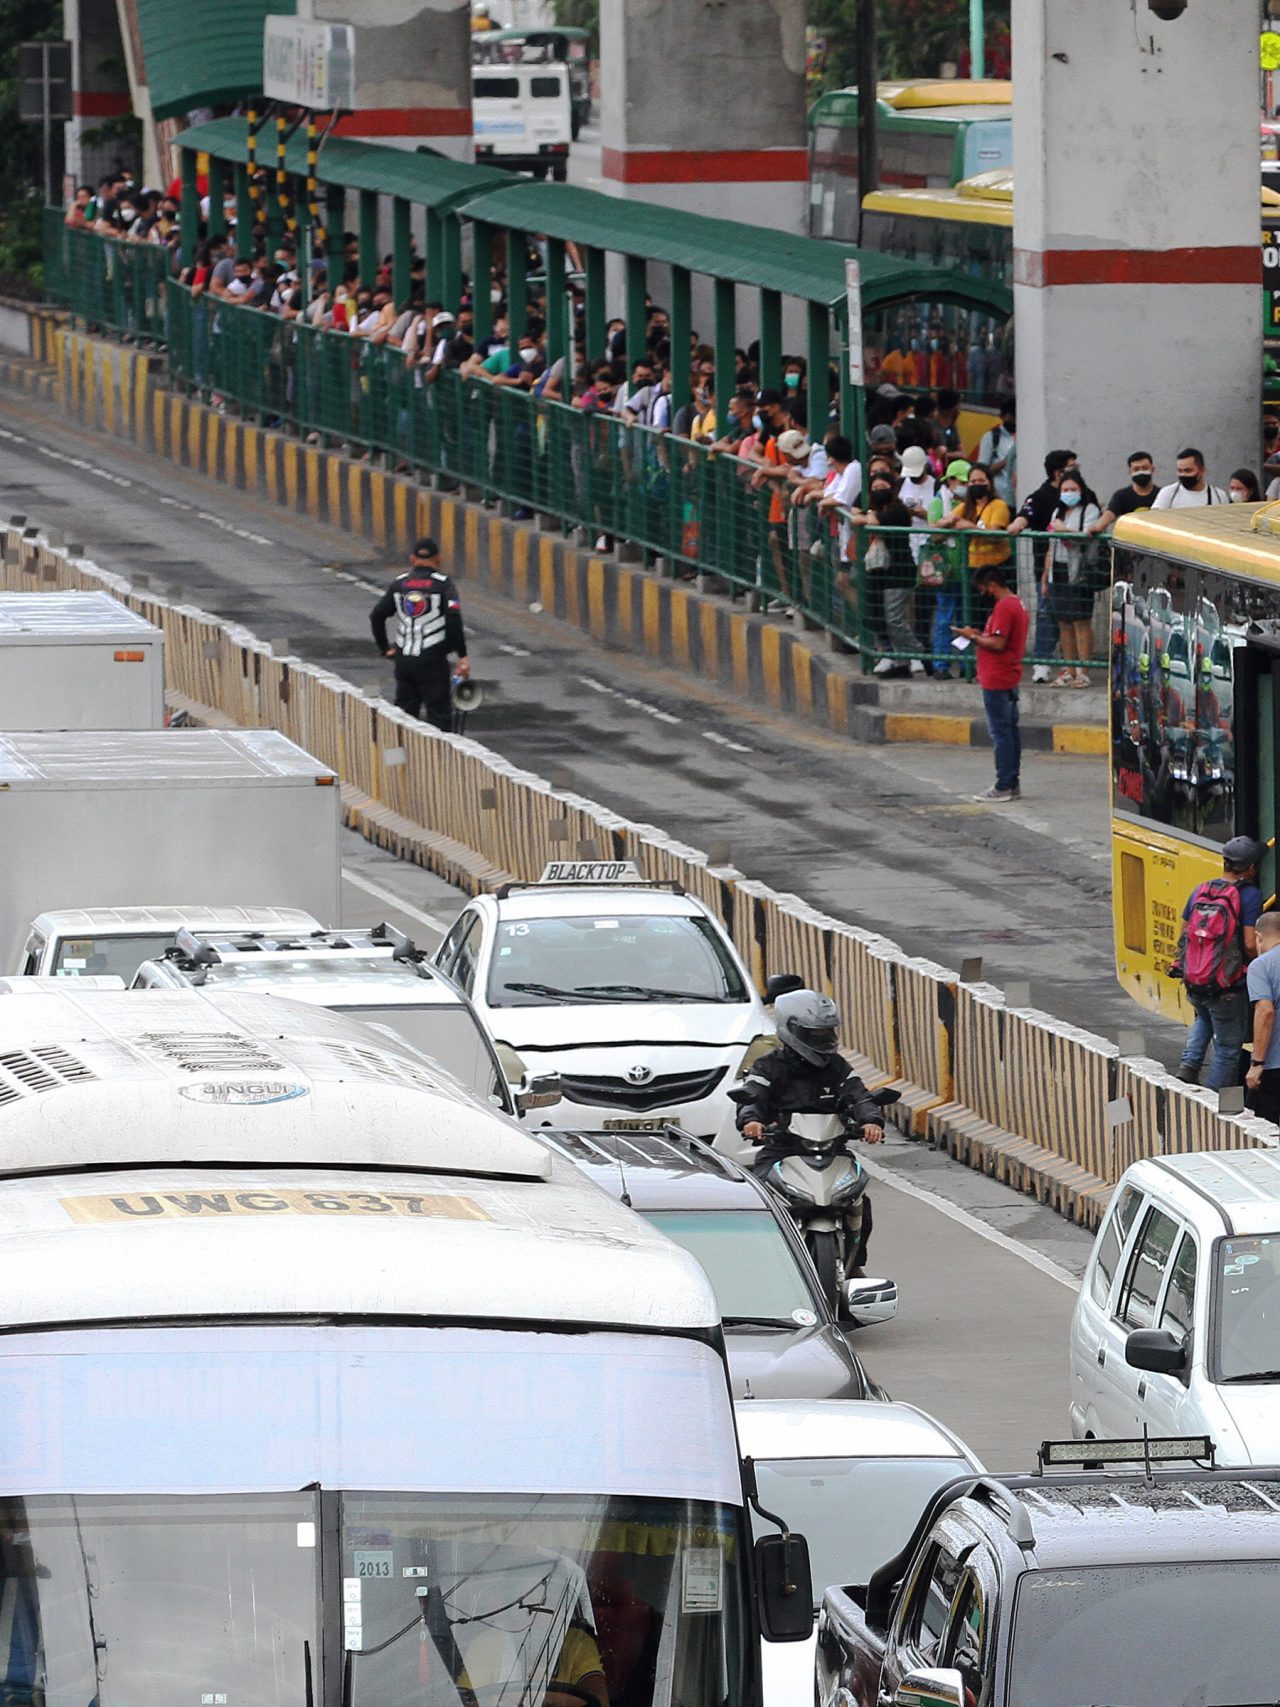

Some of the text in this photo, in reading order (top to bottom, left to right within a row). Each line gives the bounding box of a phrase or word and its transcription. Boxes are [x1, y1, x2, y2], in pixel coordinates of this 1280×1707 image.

[546, 863, 627, 880] BLACKTOP
[505, 923, 530, 937] 13
[359, 1562, 390, 1576] 2013
